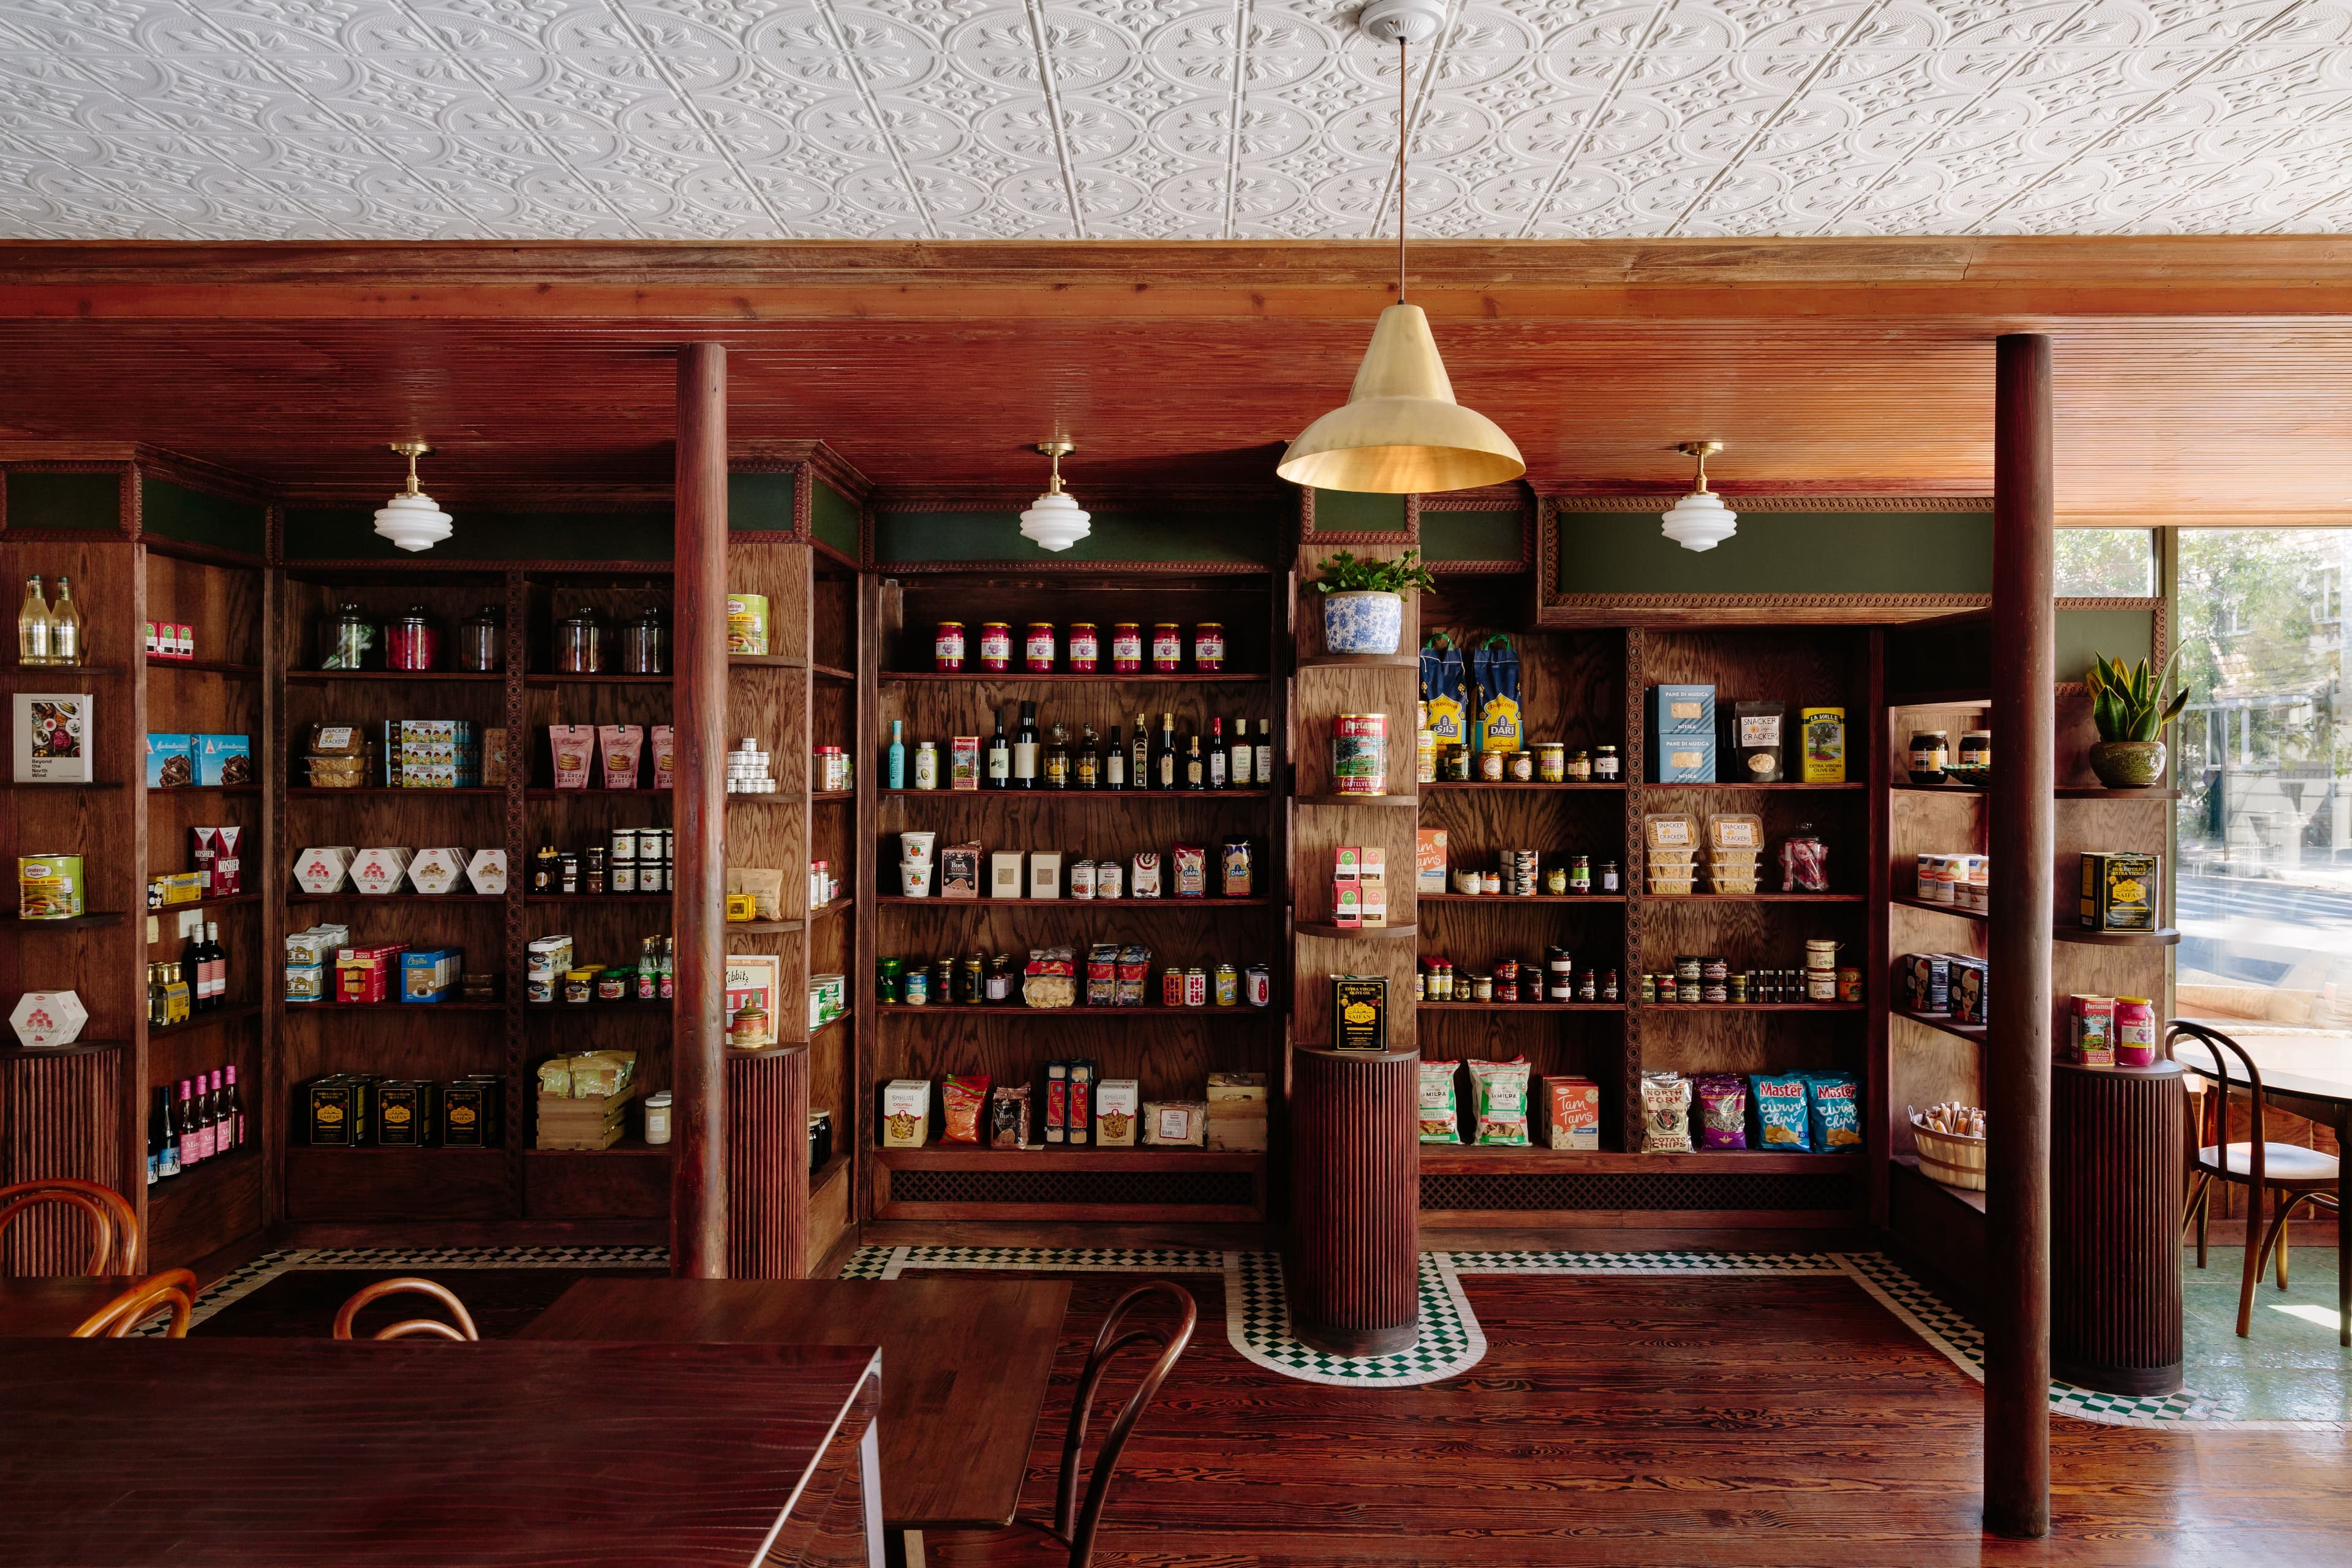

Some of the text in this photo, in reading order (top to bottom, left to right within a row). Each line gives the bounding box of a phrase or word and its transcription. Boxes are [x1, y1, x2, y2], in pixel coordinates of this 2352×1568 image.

[1345, 720, 1382, 733] Parta
[1417, 842, 1436, 854] am
[219, 859, 239, 873] KOSHER
[1417, 854, 1441, 867] ams
[407, 956, 428, 965] Cortas
[38, 1025, 62, 1038] Delight
[1760, 1082, 1803, 1097] Master
[1817, 1085, 1856, 1099] Master
[1558, 1095, 1588, 1110] Tam
[1560, 1109, 1593, 1125] Tams
[1764, 1114, 1796, 1126] chips
[1825, 1115, 1856, 1128] chips
[186, 1140, 200, 1148] Min
